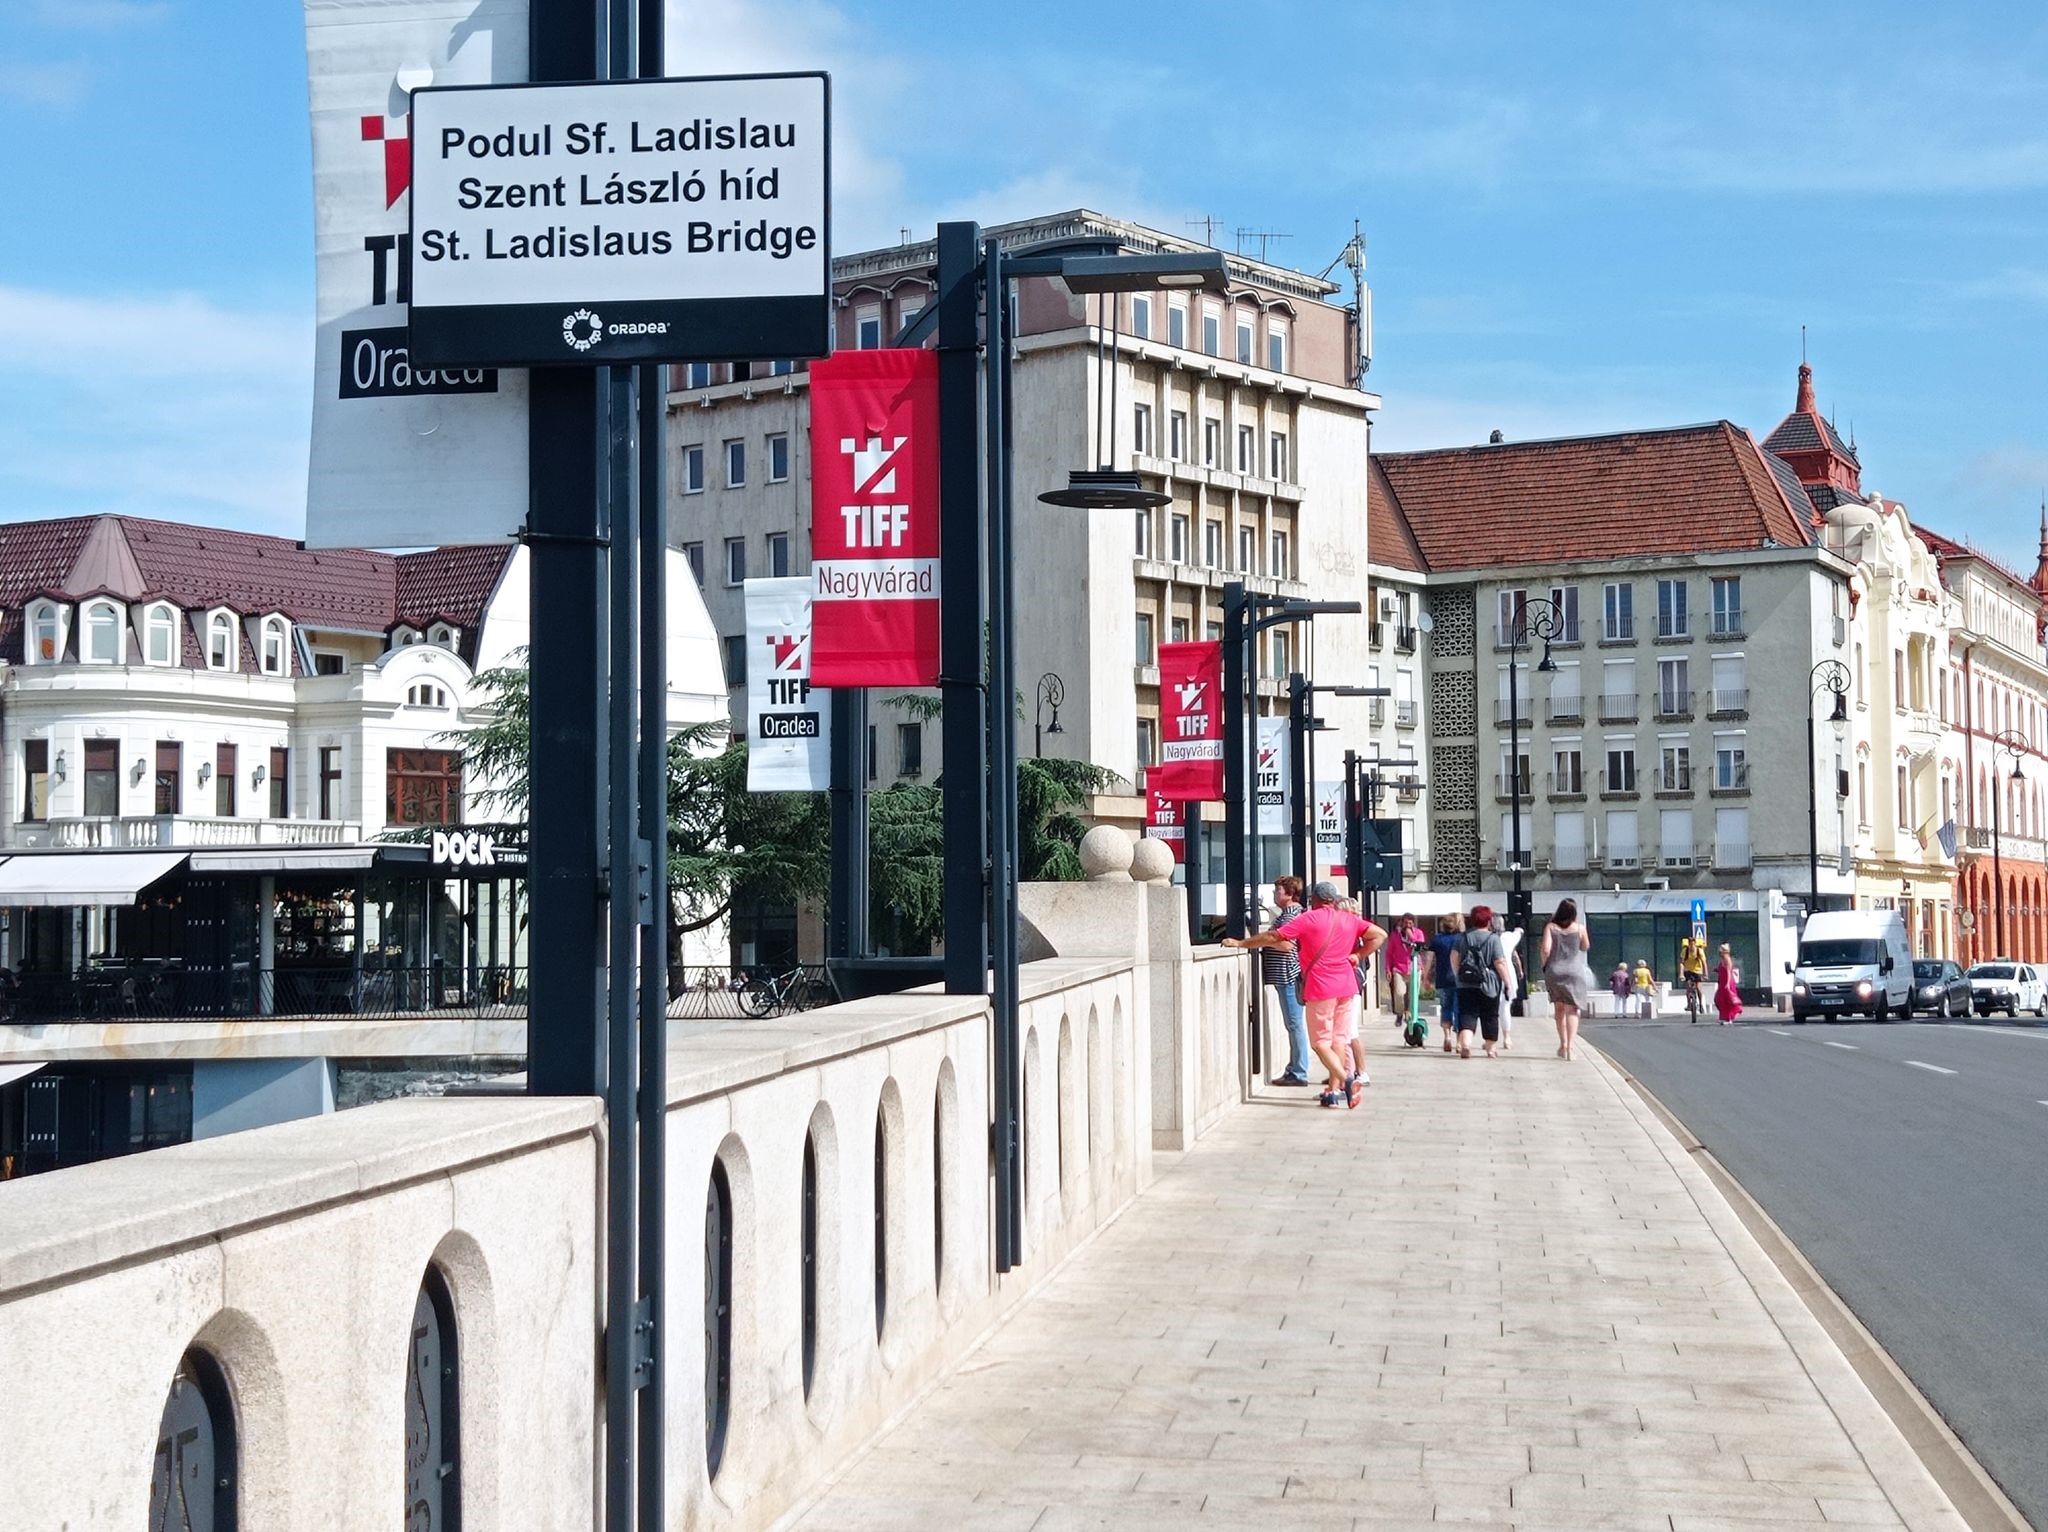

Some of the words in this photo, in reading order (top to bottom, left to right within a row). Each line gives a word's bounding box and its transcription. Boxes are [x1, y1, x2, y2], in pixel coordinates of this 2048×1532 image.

[442, 124, 551, 159] Podul
[566, 122, 615, 155] Sf.
[631, 117, 796, 152] Ladislau
[458, 176, 566, 209] Szent
[580, 169, 706, 205] László
[720, 167, 779, 200] híd
[421, 229, 470, 262] St.
[486, 225, 672, 259] Ladislaus
[688, 219, 817, 259] Bridge
[840, 505, 909, 548] TIFF
[818, 564, 932, 598] Nagyvárad
[767, 678, 811, 705] TIFF
[764, 715, 815, 736] Oradea
[1176, 714, 1209, 737] TIFF
[1166, 742, 1220, 760] Nagyvárad
[1258, 793, 1282, 804] radea
[1154, 810, 1176, 824] TIFF
[1320, 819, 1338, 830] TIFF
[433, 830, 496, 865] DOCK
